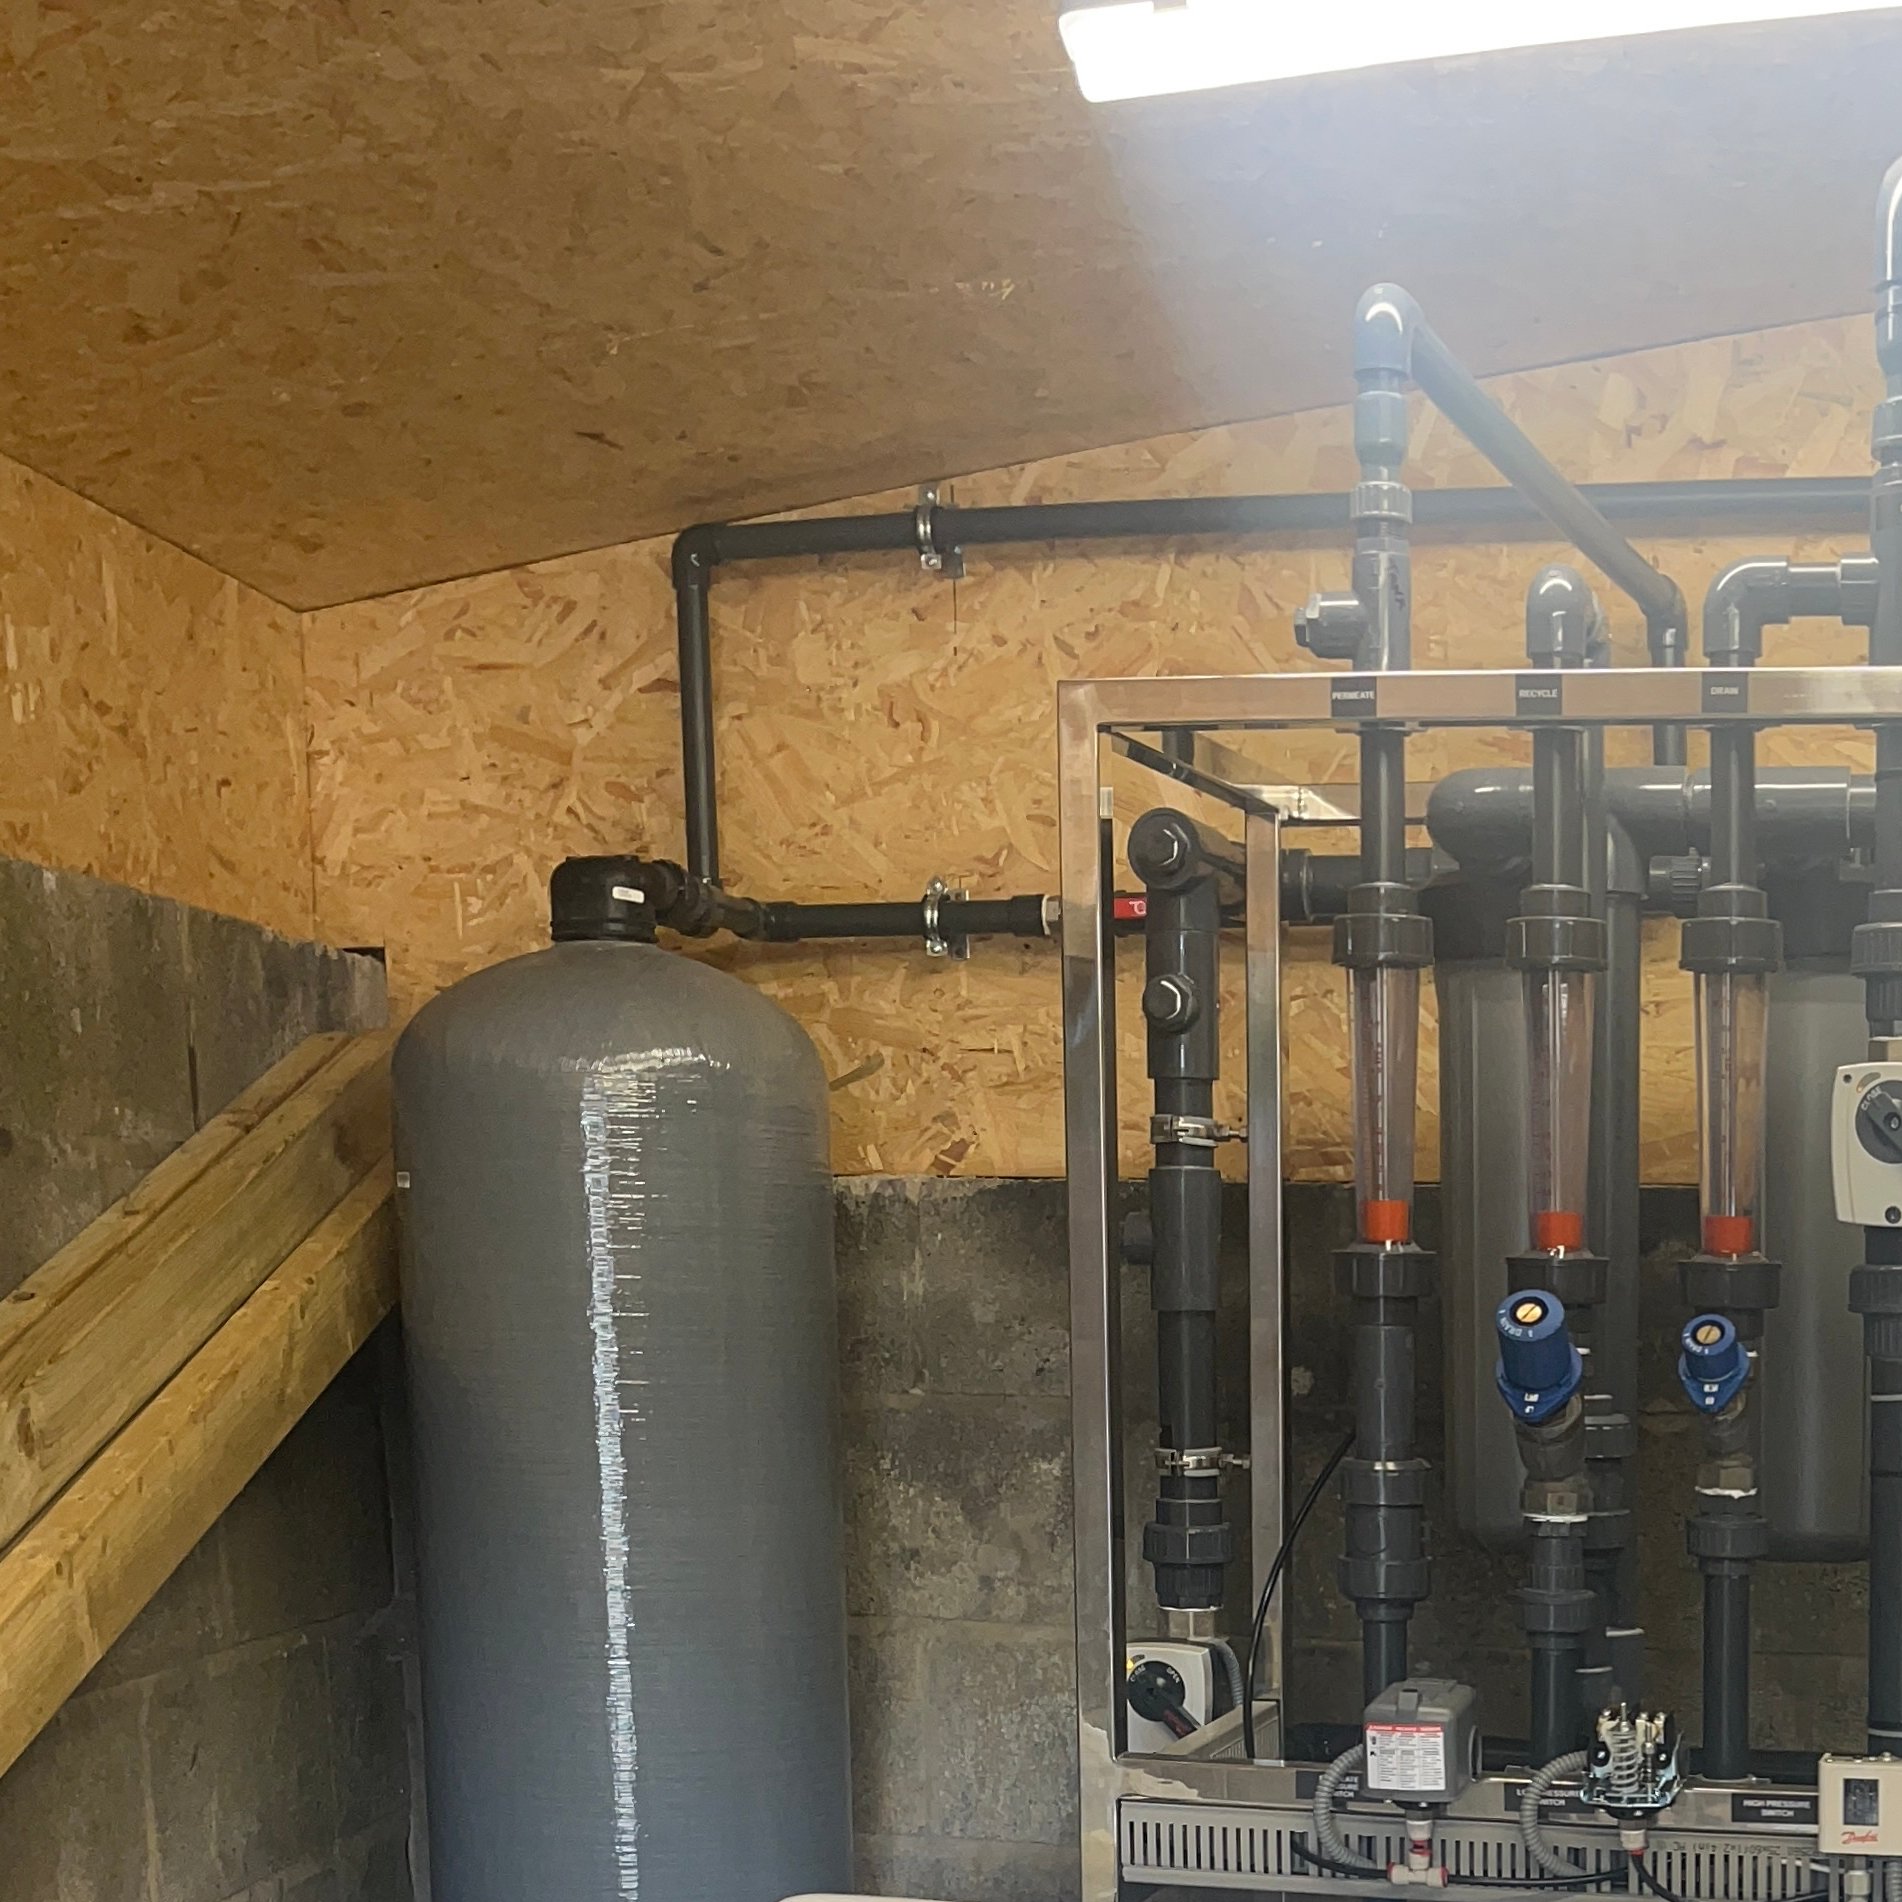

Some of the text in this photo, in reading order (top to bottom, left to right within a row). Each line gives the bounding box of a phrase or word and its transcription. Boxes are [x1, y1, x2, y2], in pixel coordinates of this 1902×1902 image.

[1332, 690, 1375, 700] PERMEATE
[1518, 688, 1558, 698] RECYCLE
[1766, 1800, 1811, 1809] PRESSURE
[1760, 1808, 1795, 1817] SWITCH
